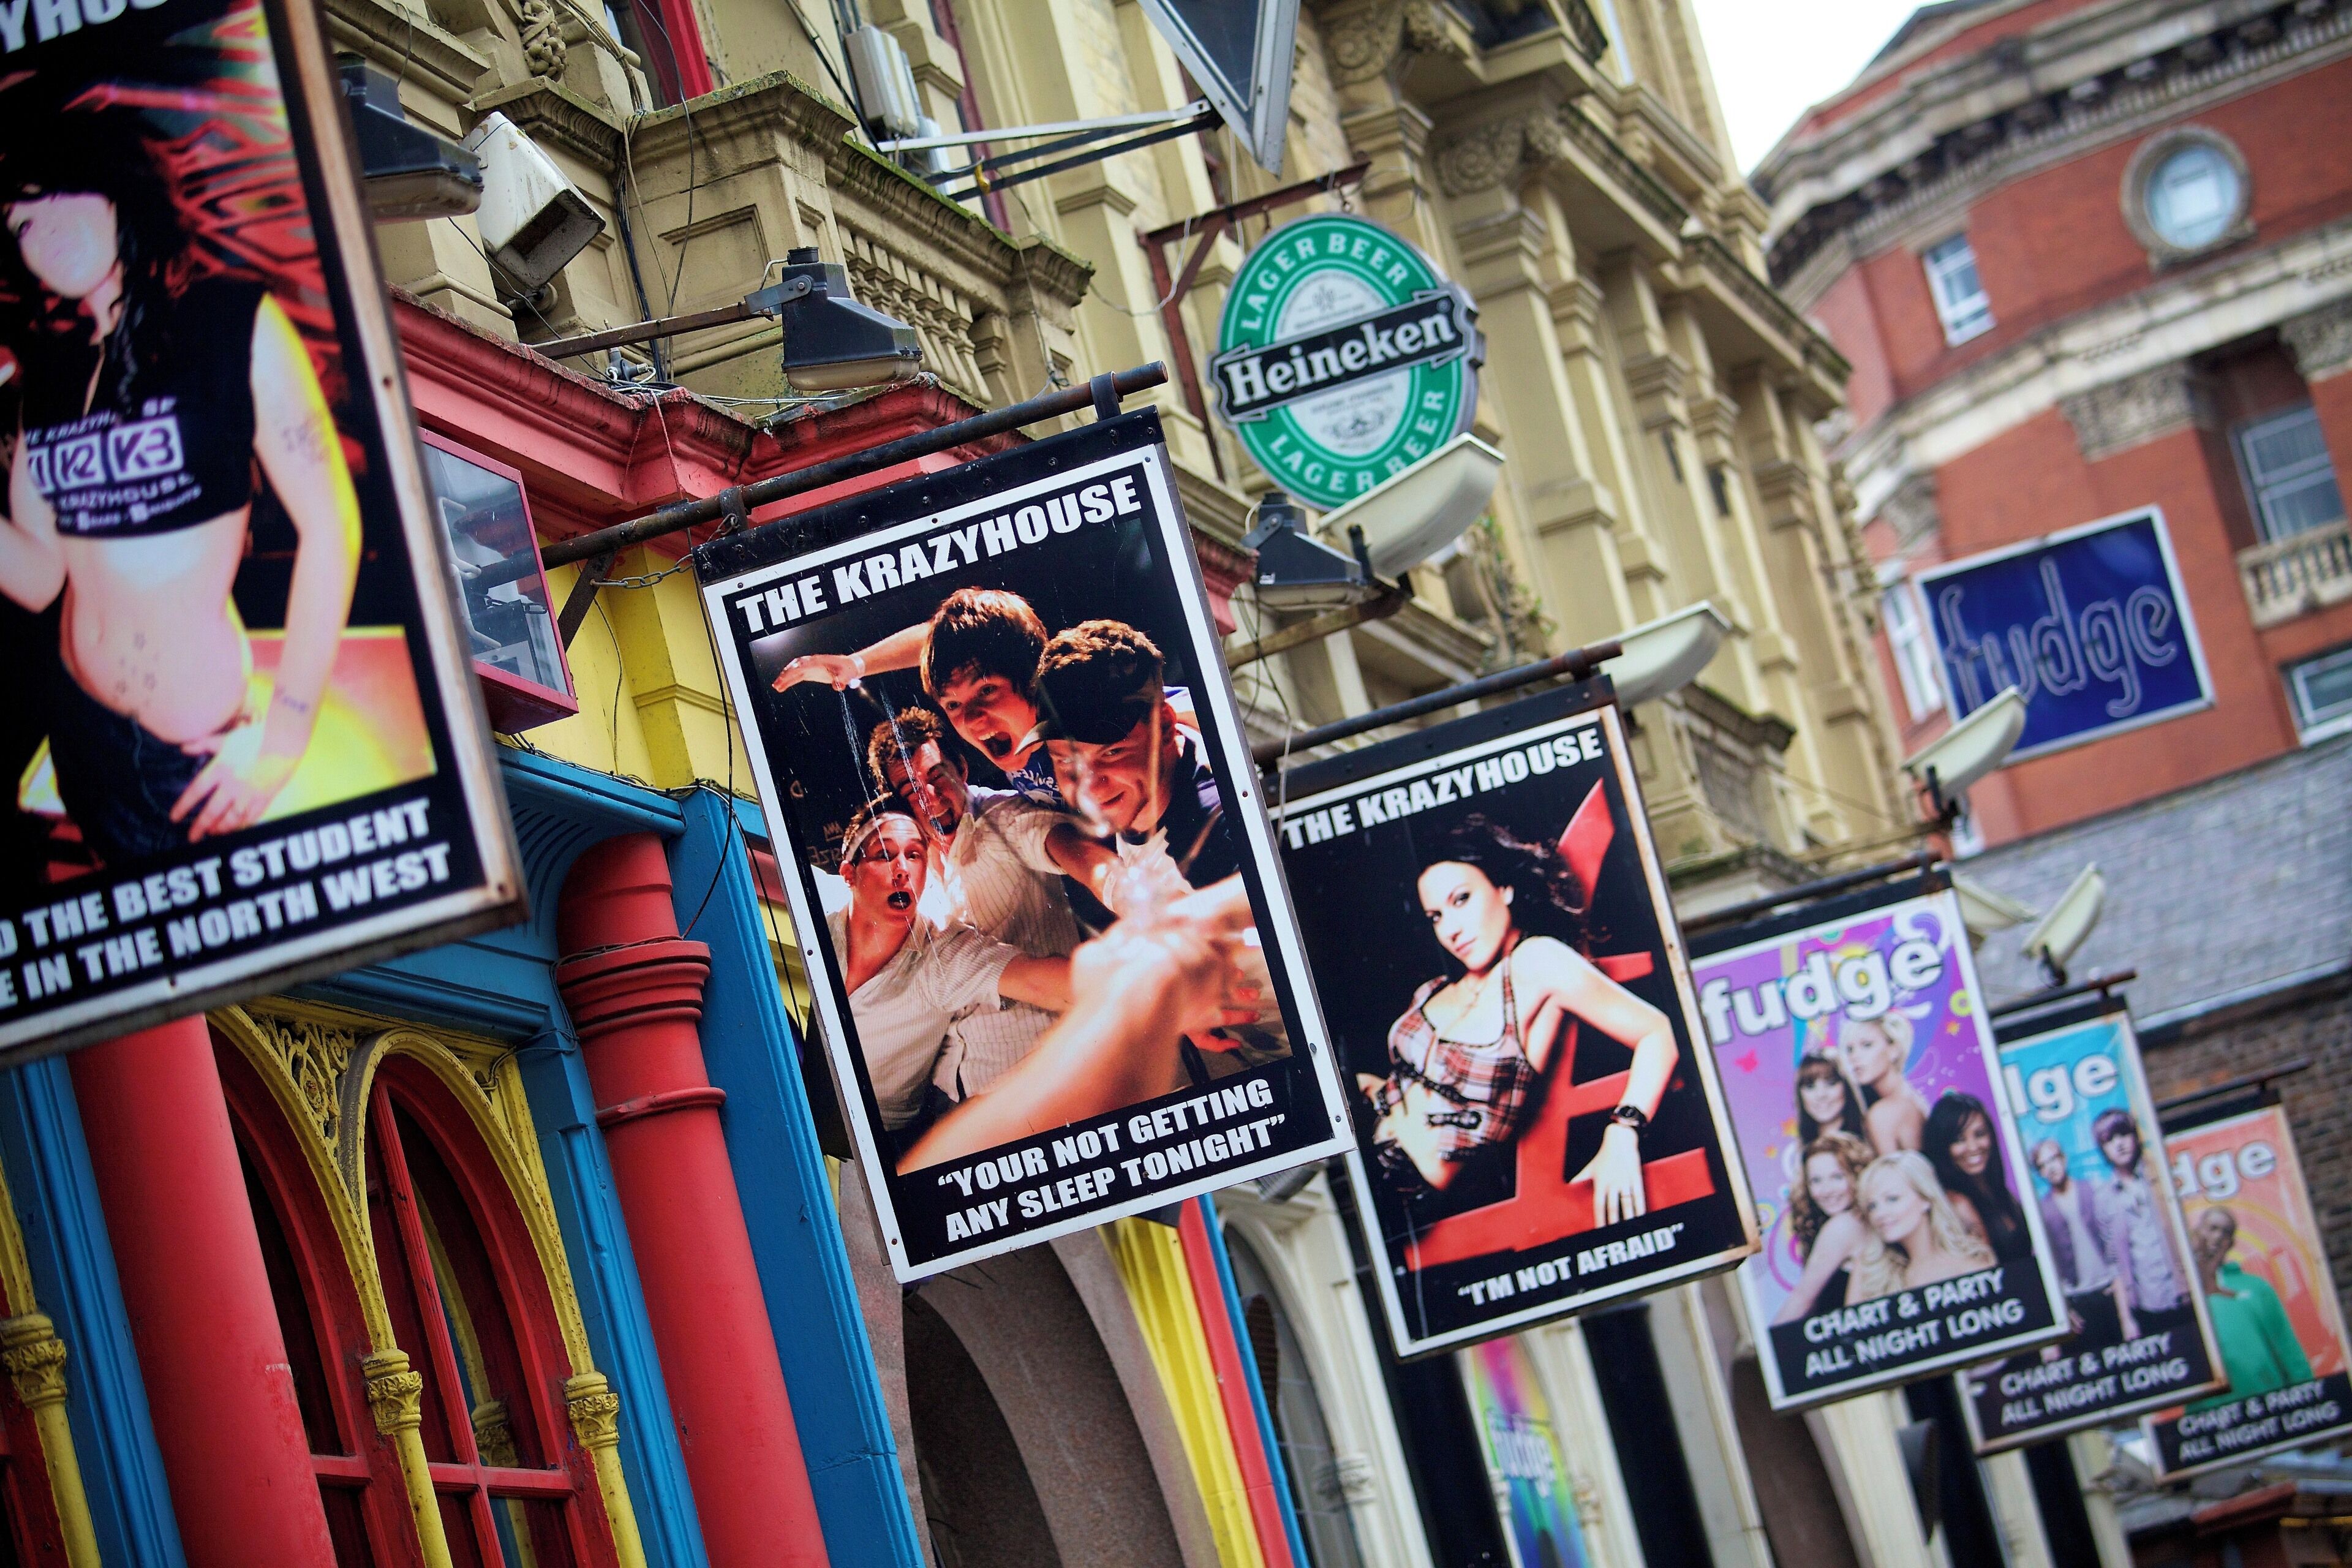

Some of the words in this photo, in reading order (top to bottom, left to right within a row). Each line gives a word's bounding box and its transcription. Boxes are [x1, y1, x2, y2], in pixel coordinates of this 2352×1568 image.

[1242, 237, 1316, 330] LAGER
[1328, 233, 1409, 287] BEER
[1224, 310, 1456, 406] Heineken
[114, 426, 176, 473] K3
[1270, 435, 1376, 494] LAGER
[1385, 390, 1445, 477] BEER
[736, 576, 828, 633] THE
[832, 475, 1142, 604] KRAZYHOUSE
[1938, 556, 2178, 718] fudge
[1282, 805, 1356, 850] THE
[1357, 728, 1604, 828] KRAZYHOUSE
[22, 891, 110, 949] THE
[111, 855, 222, 923] BEST
[230, 797, 431, 887] STUDENT
[22, 952, 73, 1001] IN
[76, 926, 164, 984] THE
[165, 880, 319, 959] NORTH
[322, 842, 451, 912] WEST
[1700, 937, 1945, 1046] fudge
[1052, 1123, 1121, 1167] NOT
[1129, 1079, 1274, 1144] GETTING
[945, 1197, 1021, 1242] ANY
[1018, 1167, 1116, 1219] SLEEP
[1516, 1256, 1572, 1292] NOT
[1803, 1298, 1891, 1344] CHART
[1898, 1292, 1921, 1319] &
[1923, 1267, 2005, 1312] PARTY
[1804, 1345, 1853, 1379] ALL
[1854, 1319, 1941, 1365] NIGHT
[1945, 1297, 2026, 1340] LONG
[1999, 1357, 2075, 1397] CHART
[2079, 1351, 2102, 1377] &
[2102, 1330, 2173, 1370] PARTY
[2000, 1396, 2042, 1427] ALL
[2043, 1375, 2118, 1414] NIGHT
[2120, 1356, 2190, 1393] LONG
[2177, 1401, 2245, 1438] CHART
[2264, 1379, 2325, 1413] PARTY
[2179, 1434, 2216, 1463] ALL
[2215, 1415, 2281, 1452] NIGHT
[2281, 1399, 2342, 1433] LONG
